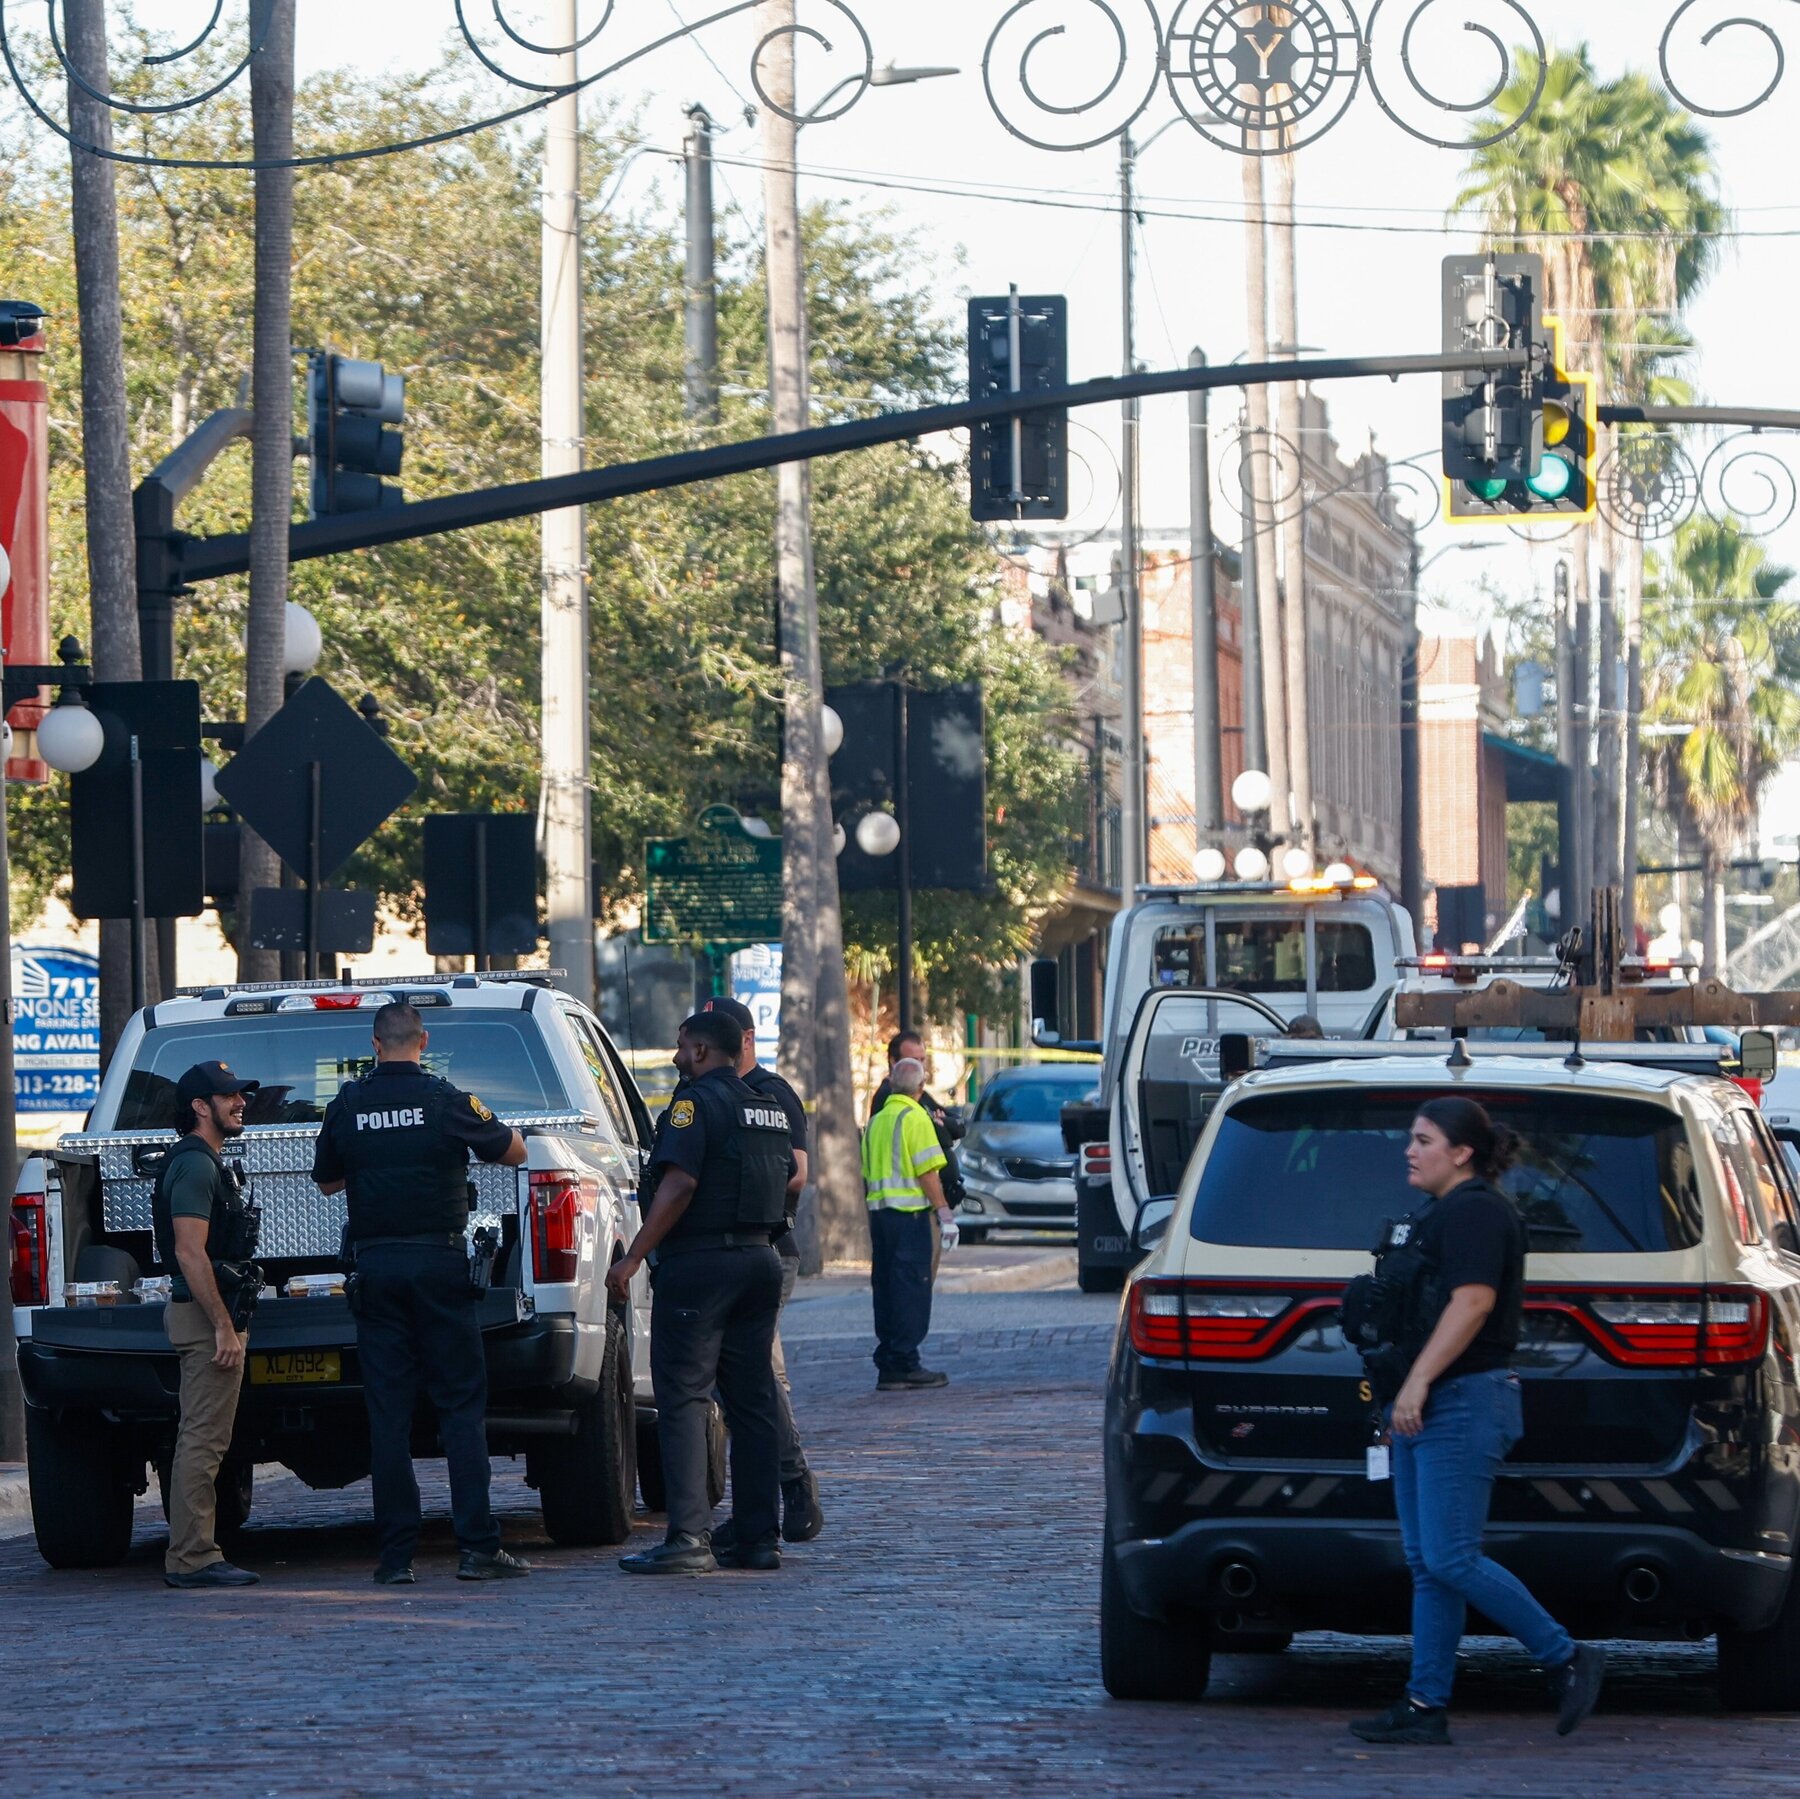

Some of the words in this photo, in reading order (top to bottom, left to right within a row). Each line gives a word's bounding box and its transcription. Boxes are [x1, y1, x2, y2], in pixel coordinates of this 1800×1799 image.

[1243, 33, 1285, 79] Y
[44, 1034, 100, 1051] AVAIL
[356, 1107, 425, 1131] POLICE
[743, 1108, 789, 1130] POLICE
